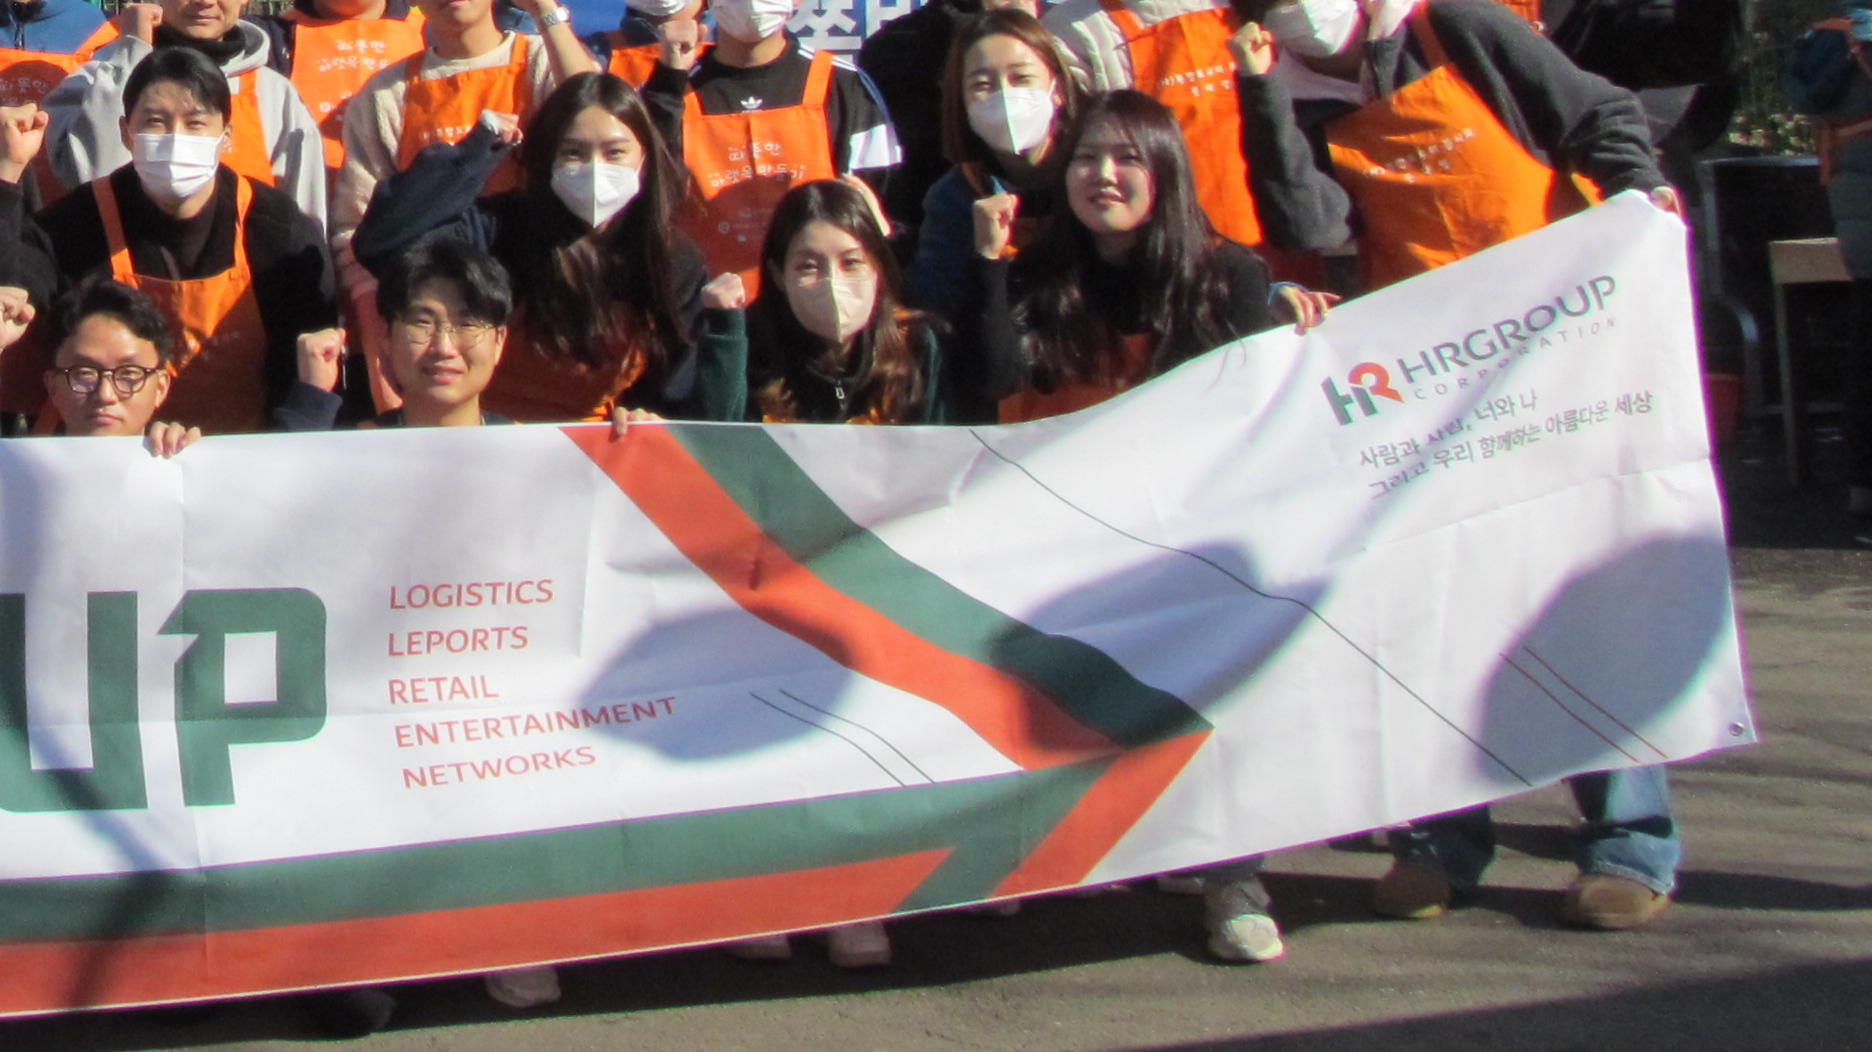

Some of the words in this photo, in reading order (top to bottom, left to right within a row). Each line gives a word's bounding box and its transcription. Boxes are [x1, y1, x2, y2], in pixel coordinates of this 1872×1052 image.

[1396, 275, 1617, 385] HRGROUP
[1414, 316, 1618, 401] CORPORATION
[1359, 438, 1421, 468] 사람과
[1473, 394, 1517, 422] 너와
[1519, 388, 1539, 410] 나
[1368, 462, 1430, 500] 그리고
[1433, 441, 1475, 469] 우리
[1477, 423, 1542, 460] 함께하는
[1544, 400, 1610, 435] 아름다운
[1613, 390, 1653, 416] 세상
[388, 579, 554, 610] LOGISTICS
[387, 625, 529, 657] LEPORTS
[387, 674, 500, 705] RETAIL
[393, 695, 678, 749] ENTERTAINMENT
[401, 745, 597, 789] NETWORKS
